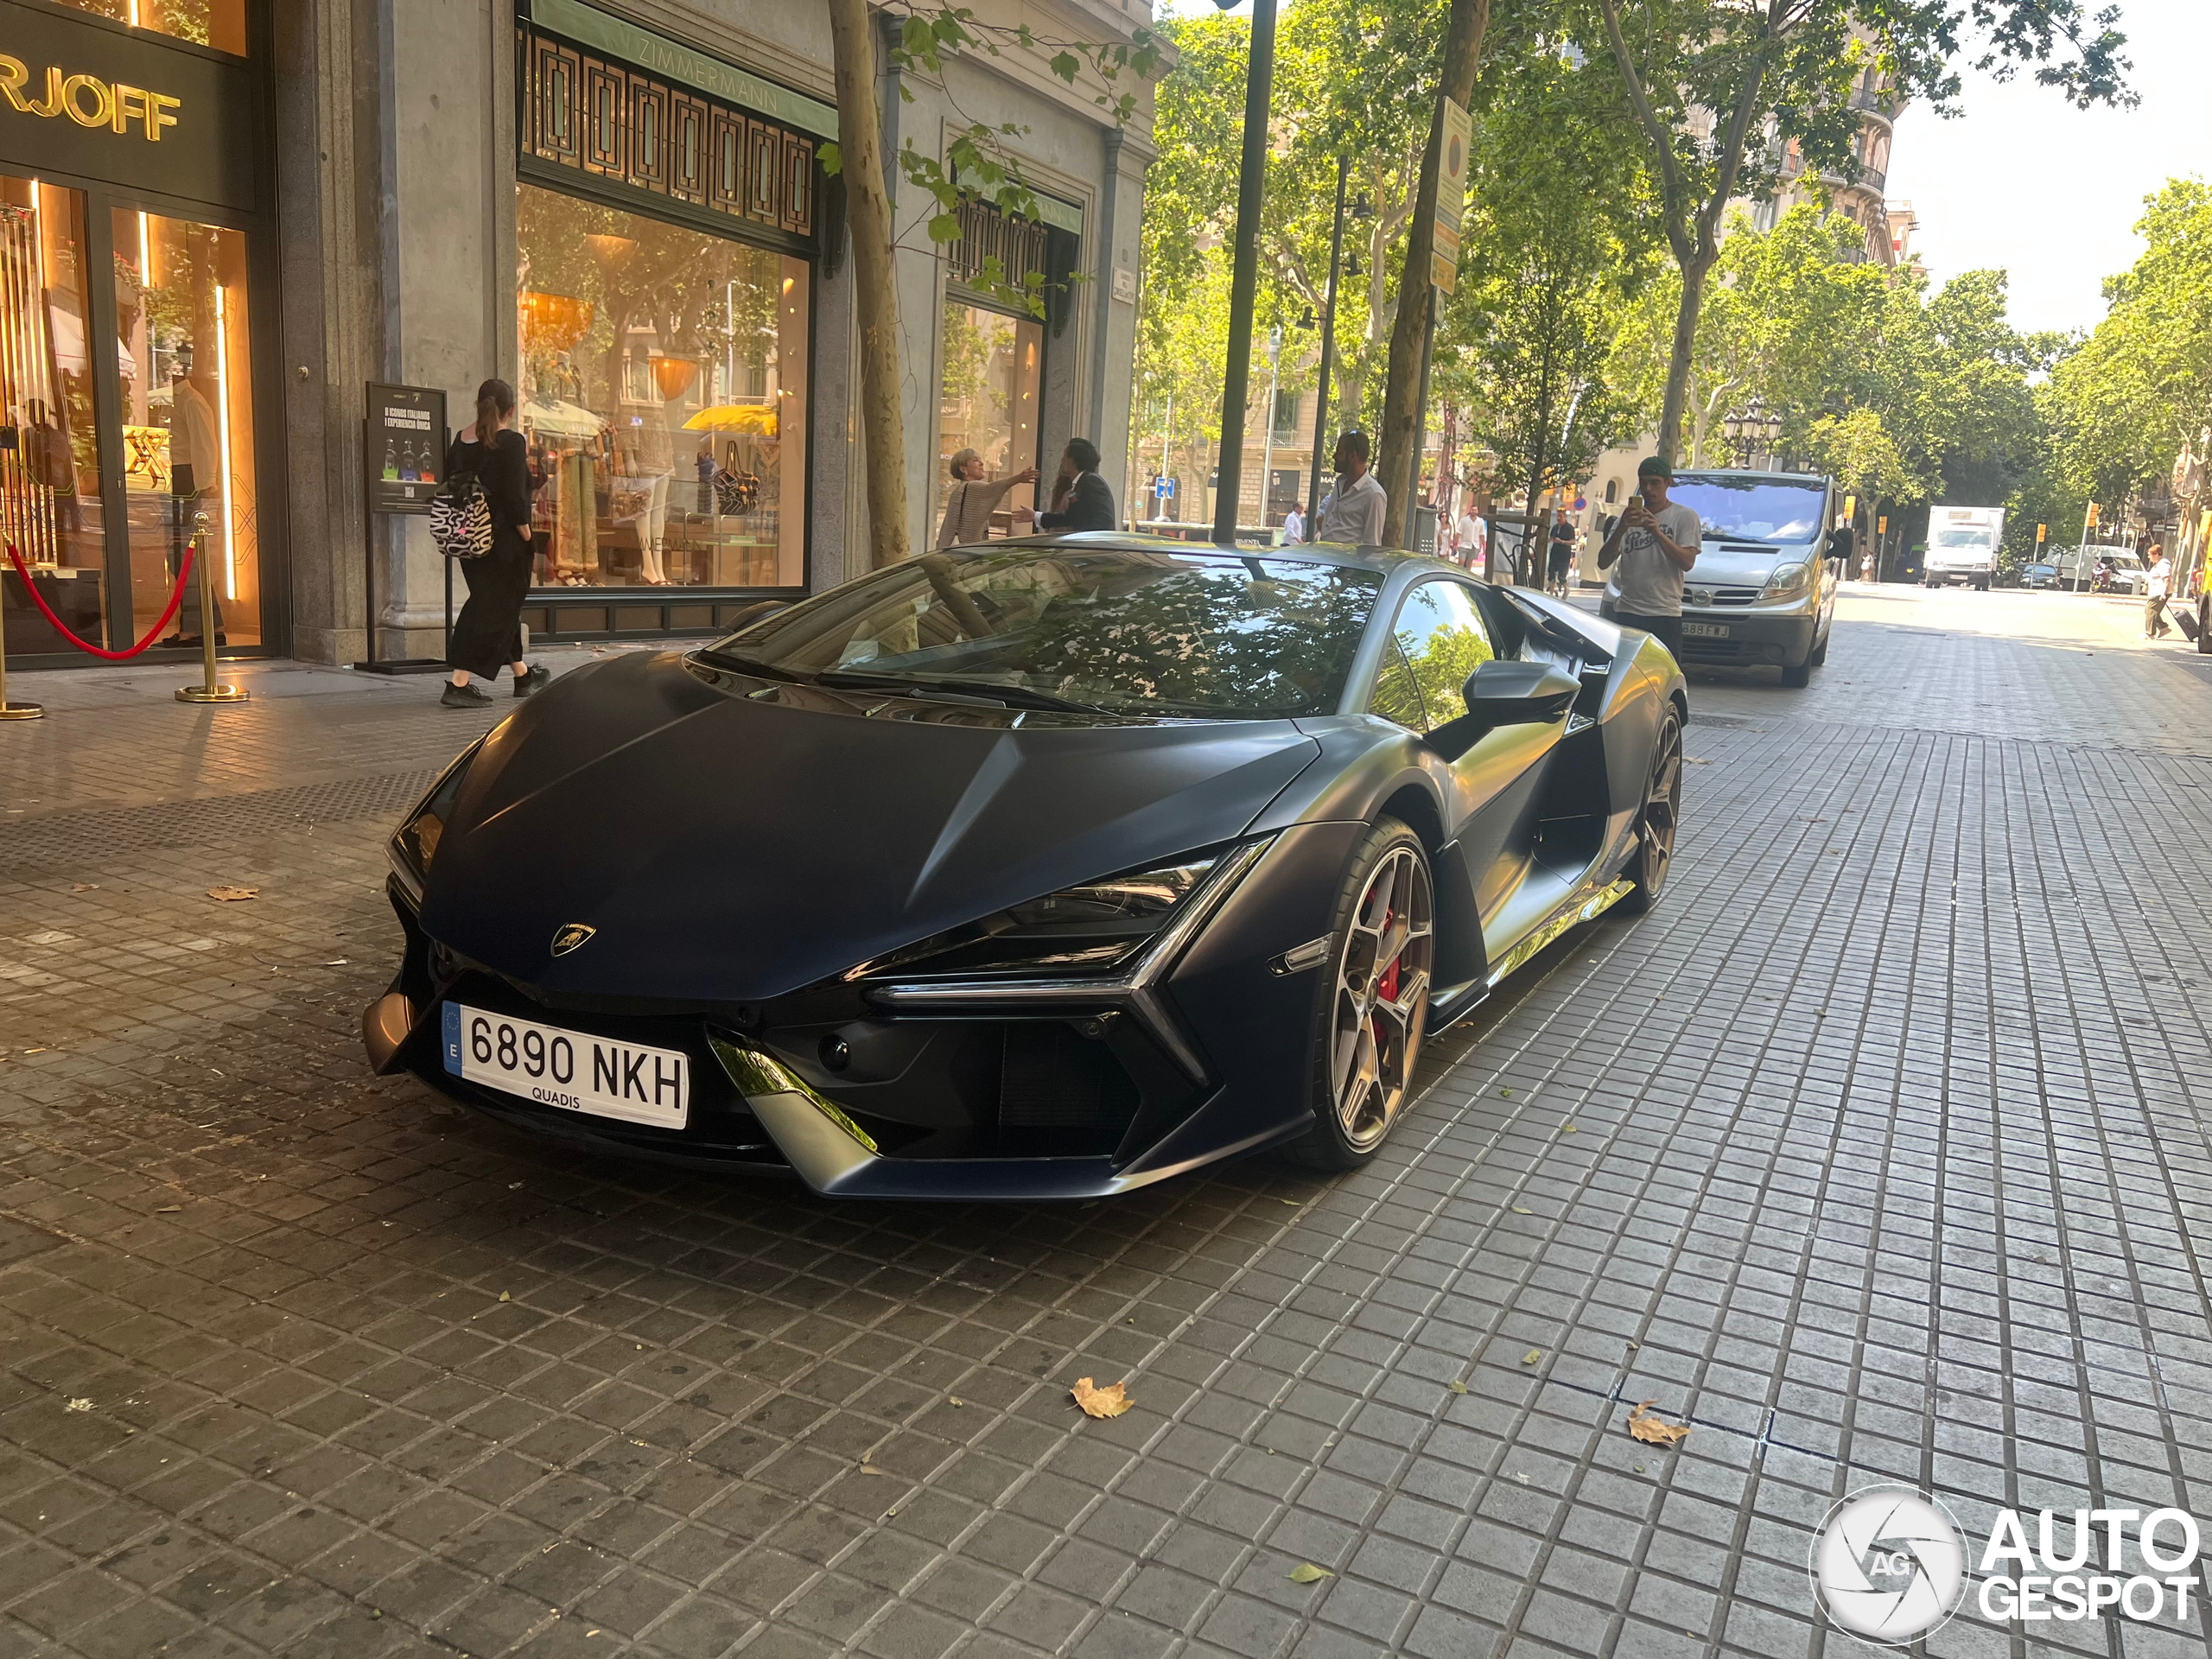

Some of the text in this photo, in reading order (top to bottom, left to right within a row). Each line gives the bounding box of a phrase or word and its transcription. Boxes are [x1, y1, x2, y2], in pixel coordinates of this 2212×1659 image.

[639, 37, 778, 112] ZIMMERMANN
[1682, 623, 1704, 635] 888
[449, 1044, 458, 1058] E
[471, 1017, 681, 1109] 6890 NKH
[532, 1087, 581, 1109] QUADIS
